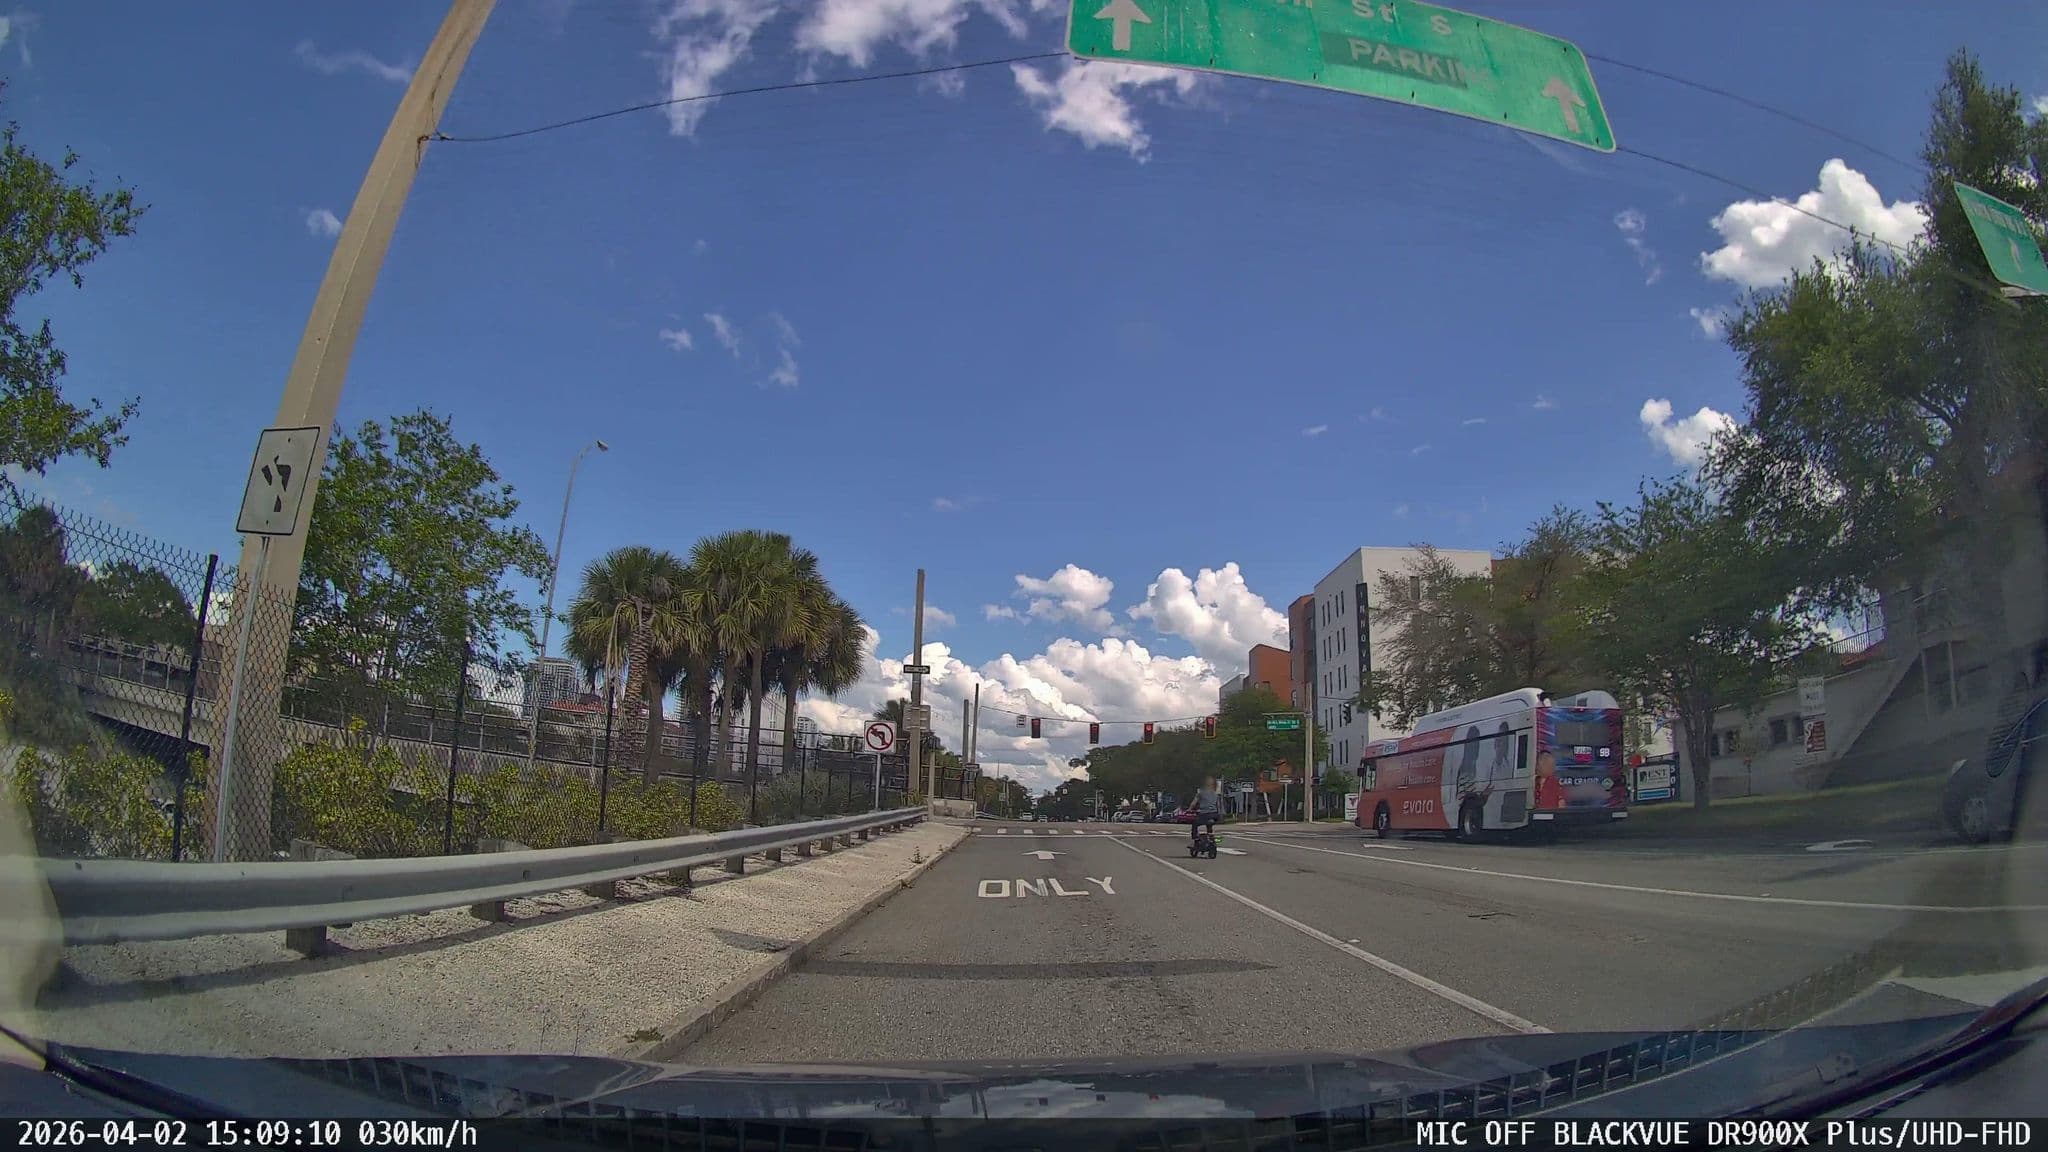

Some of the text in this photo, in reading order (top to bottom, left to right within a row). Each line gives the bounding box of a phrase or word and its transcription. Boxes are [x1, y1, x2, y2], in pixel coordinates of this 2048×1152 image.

[1430, 15, 1452, 36] S
[1349, 38, 1494, 91] PARKIN
[1403, 800, 1433, 814] evara
[977, 876, 1116, 898] ONLY
